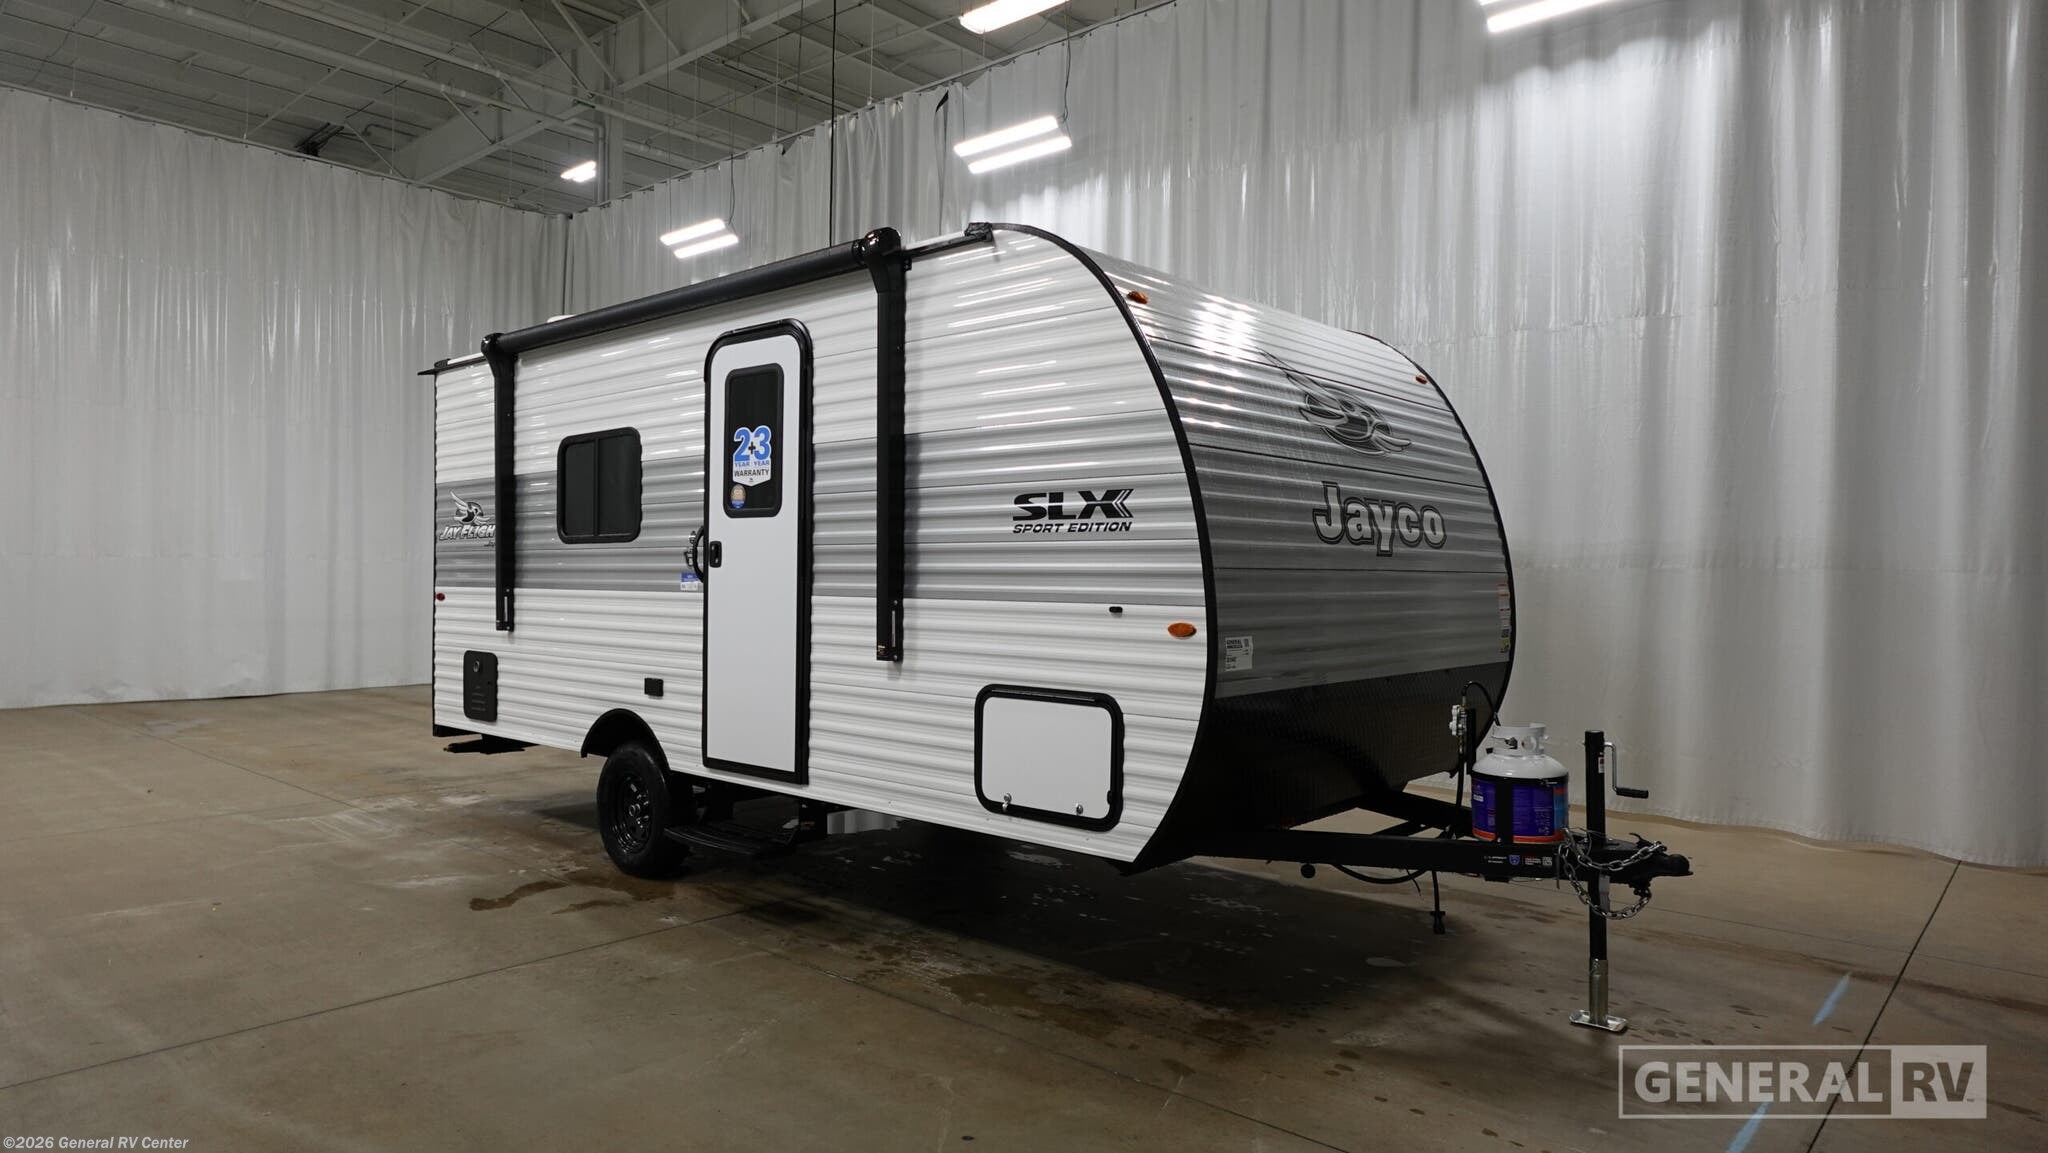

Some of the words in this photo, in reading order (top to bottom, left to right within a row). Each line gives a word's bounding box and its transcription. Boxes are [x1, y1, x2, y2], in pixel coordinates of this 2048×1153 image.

[734, 469, 769, 477] WARRANTY
[1012, 489, 1134, 521] SLX
[1312, 481, 1447, 557] Jayco
[440, 526, 461, 540] JAY
[461, 525, 496, 538] FLIGH
[1013, 523, 1063, 533] SPORT
[1067, 522, 1132, 532] EDITION
